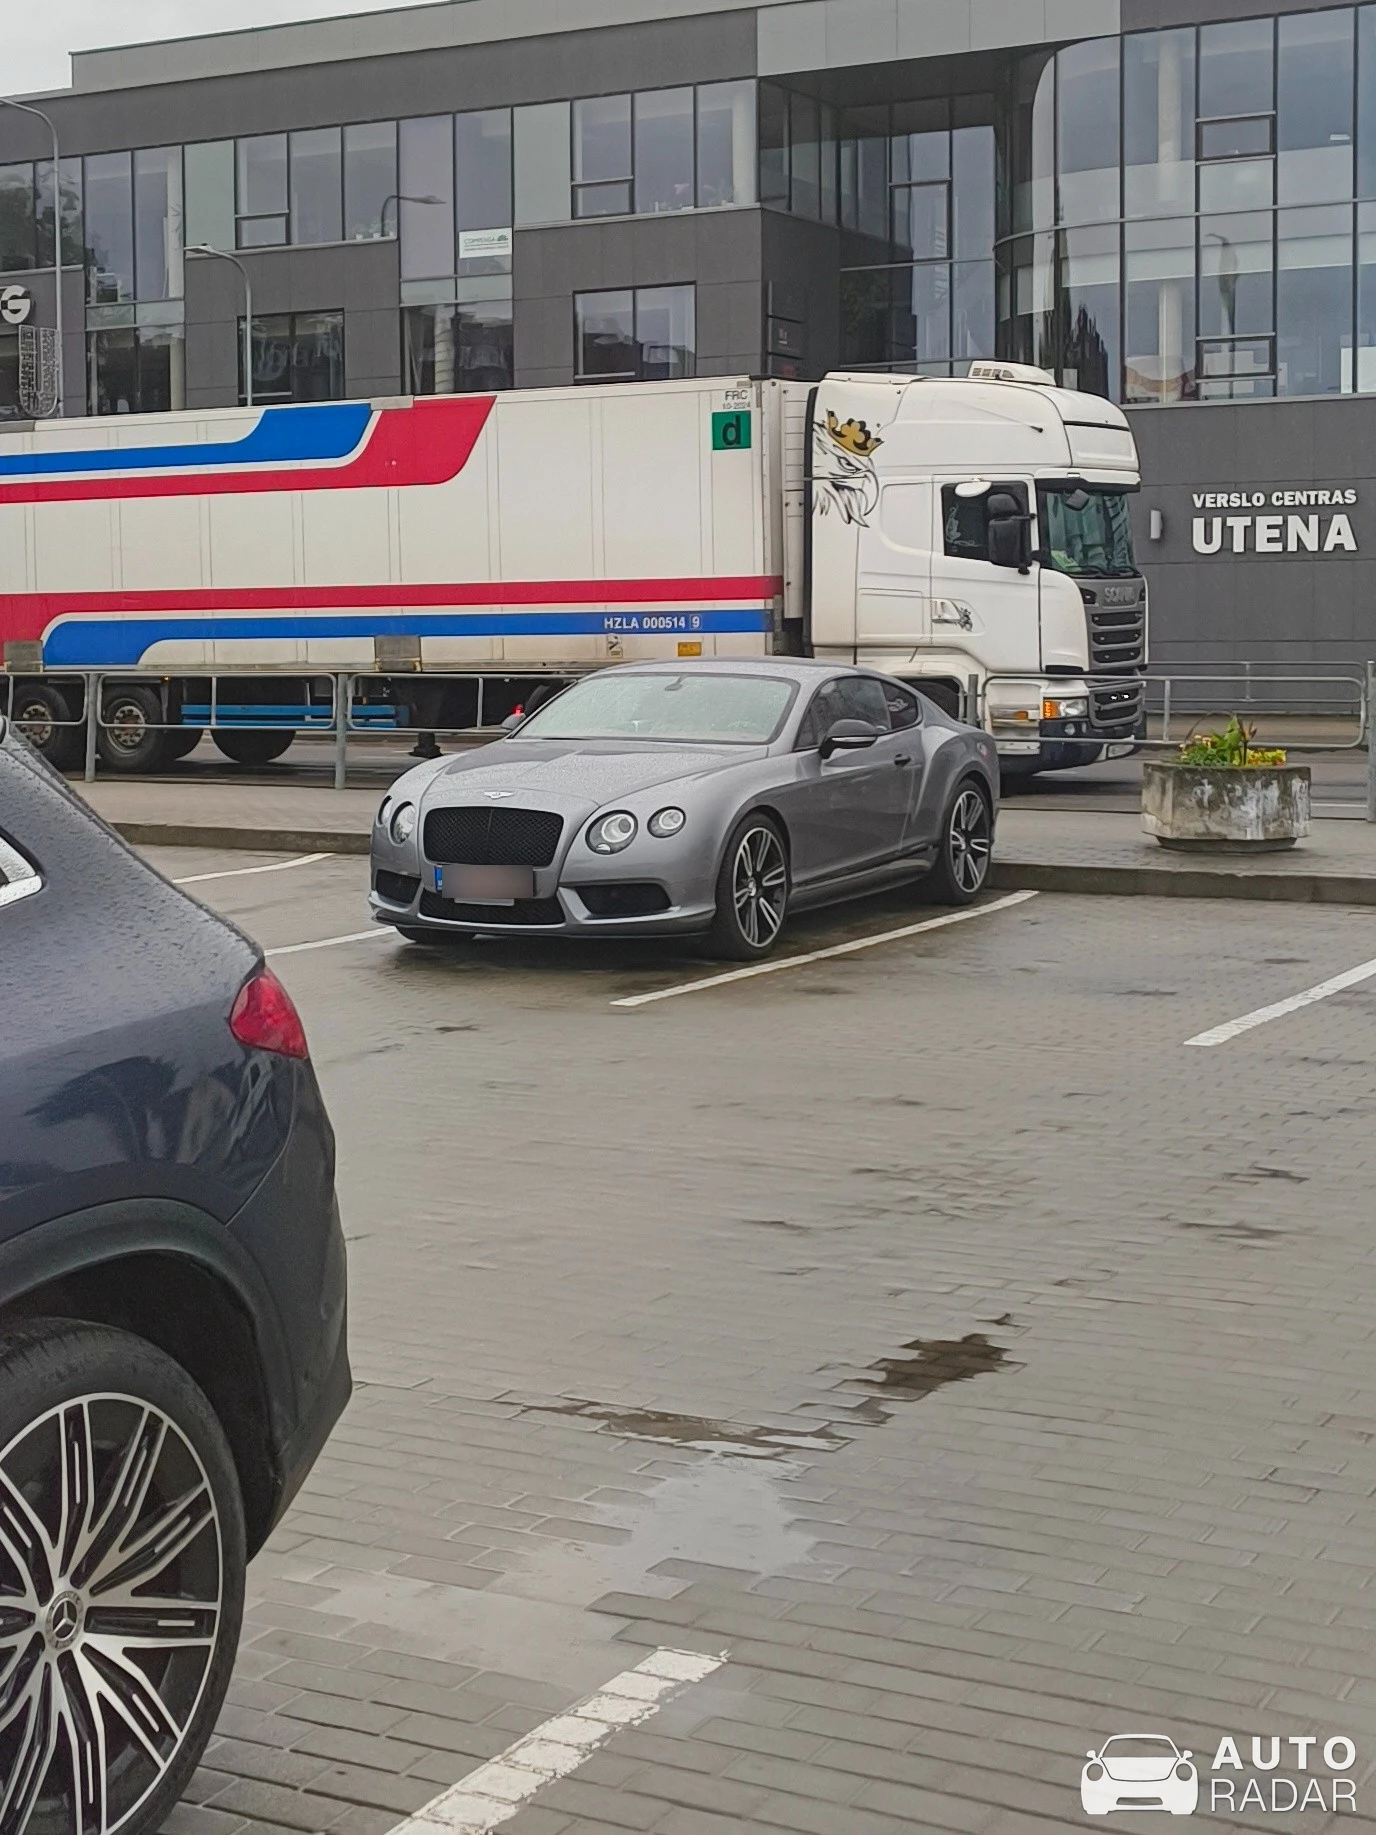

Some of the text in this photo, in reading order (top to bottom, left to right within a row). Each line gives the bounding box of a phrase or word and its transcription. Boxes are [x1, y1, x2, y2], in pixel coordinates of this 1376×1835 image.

[725, 389, 748, 400] FRC
[722, 415, 741, 446] d
[1192, 489, 1357, 508] VERSLO CENTRAS
[1192, 514, 1358, 554] UTENA
[604, 616, 700, 629] HZLA 000514 9
